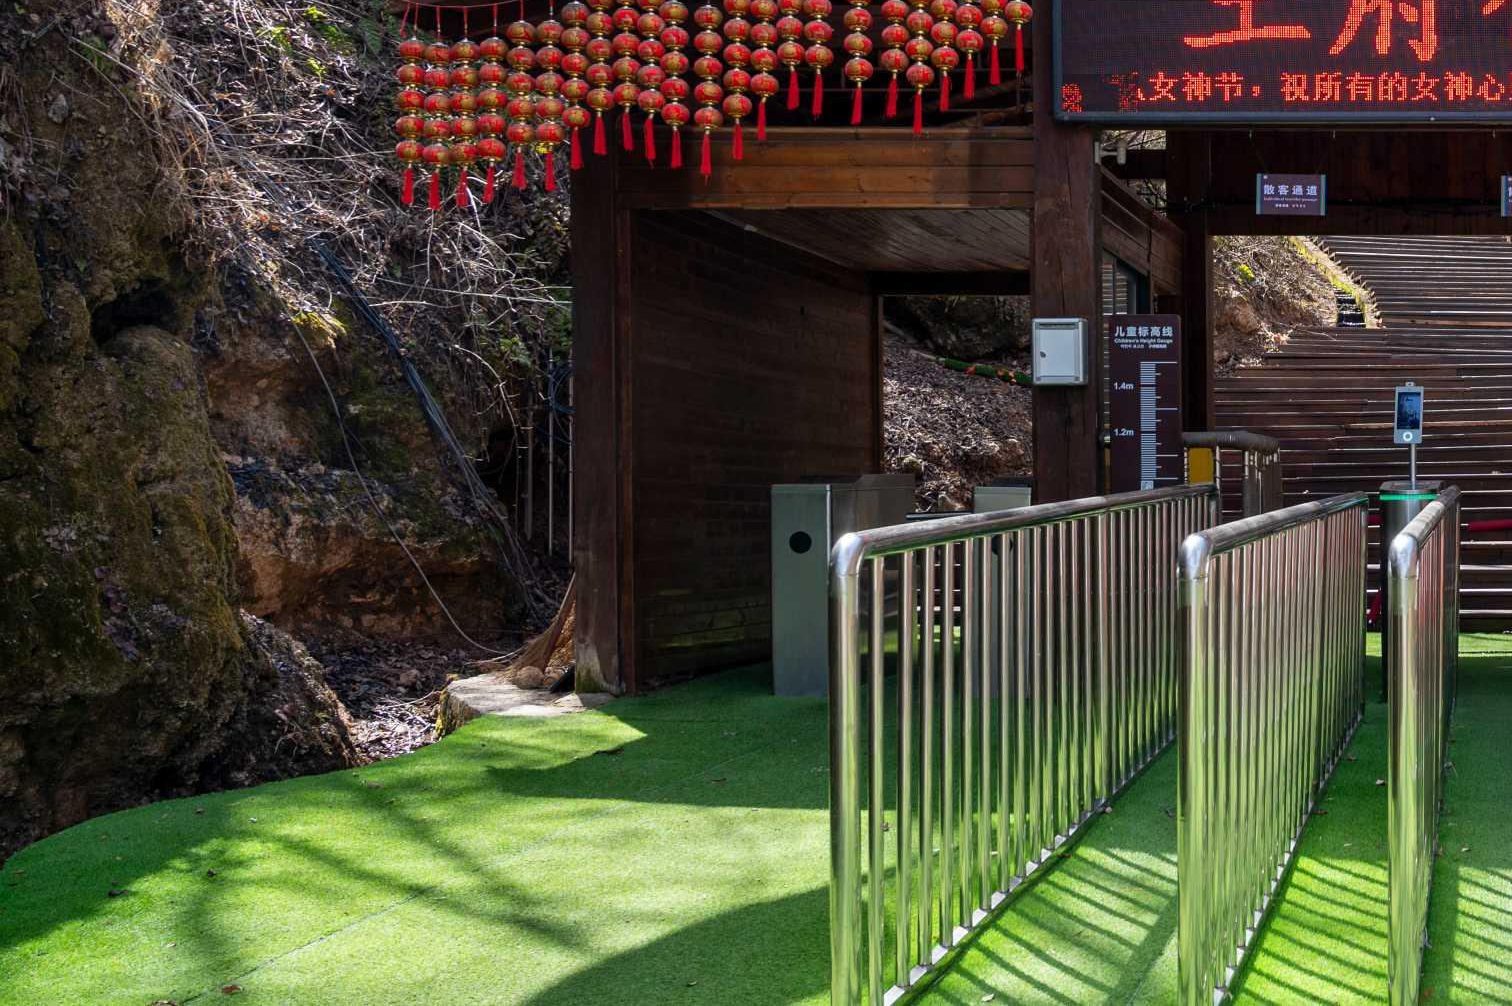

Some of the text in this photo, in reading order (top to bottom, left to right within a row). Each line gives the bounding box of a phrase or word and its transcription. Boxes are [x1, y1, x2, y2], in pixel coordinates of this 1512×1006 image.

[1263, 184, 1318, 196] 散客通道
[1114, 326, 1173, 338] 儿童标高线
[1113, 381, 1134, 391] 1.4m
[1113, 428, 1134, 437] 1.2m
